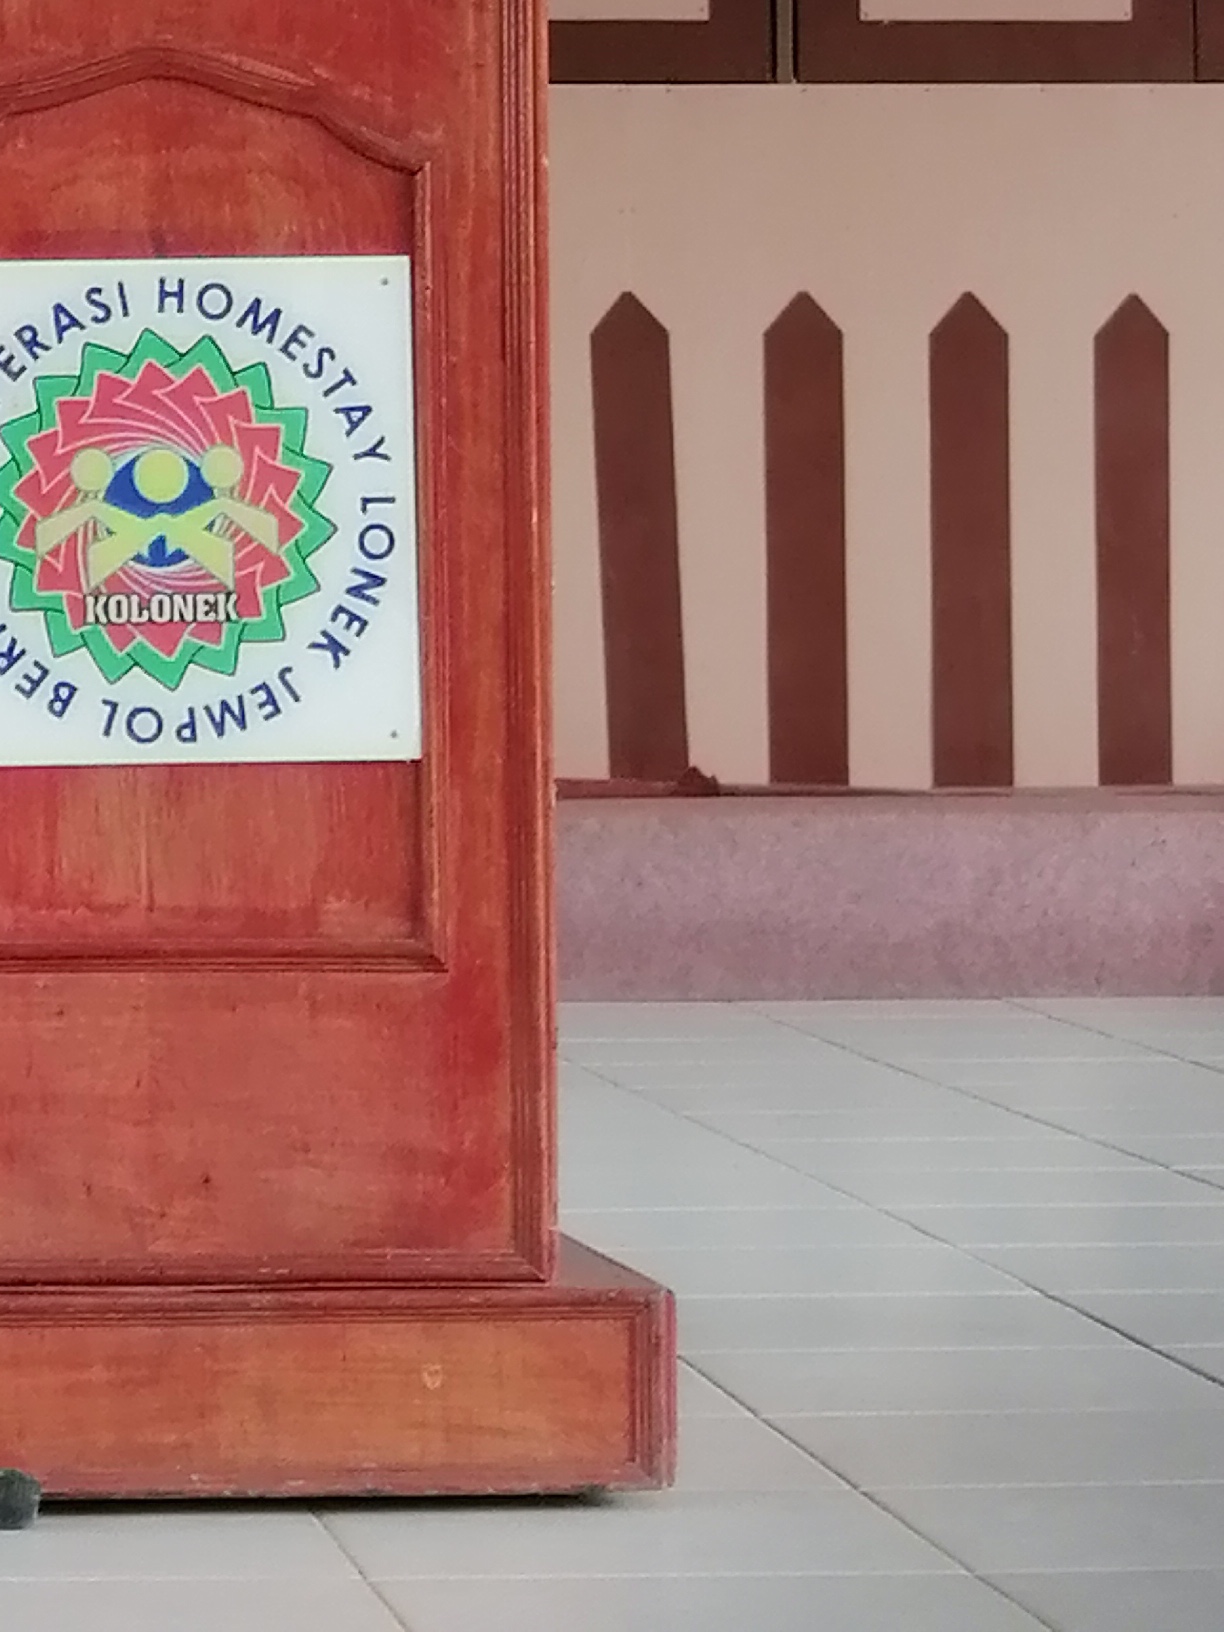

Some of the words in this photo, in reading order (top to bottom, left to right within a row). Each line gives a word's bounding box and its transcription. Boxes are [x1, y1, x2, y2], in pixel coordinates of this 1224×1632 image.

[157, 277, 392, 463] HOMESTAY
[84, 592, 238, 625] KOLONEK
[306, 495, 398, 670] LONEK
[101, 667, 302, 744] JEMPOL
